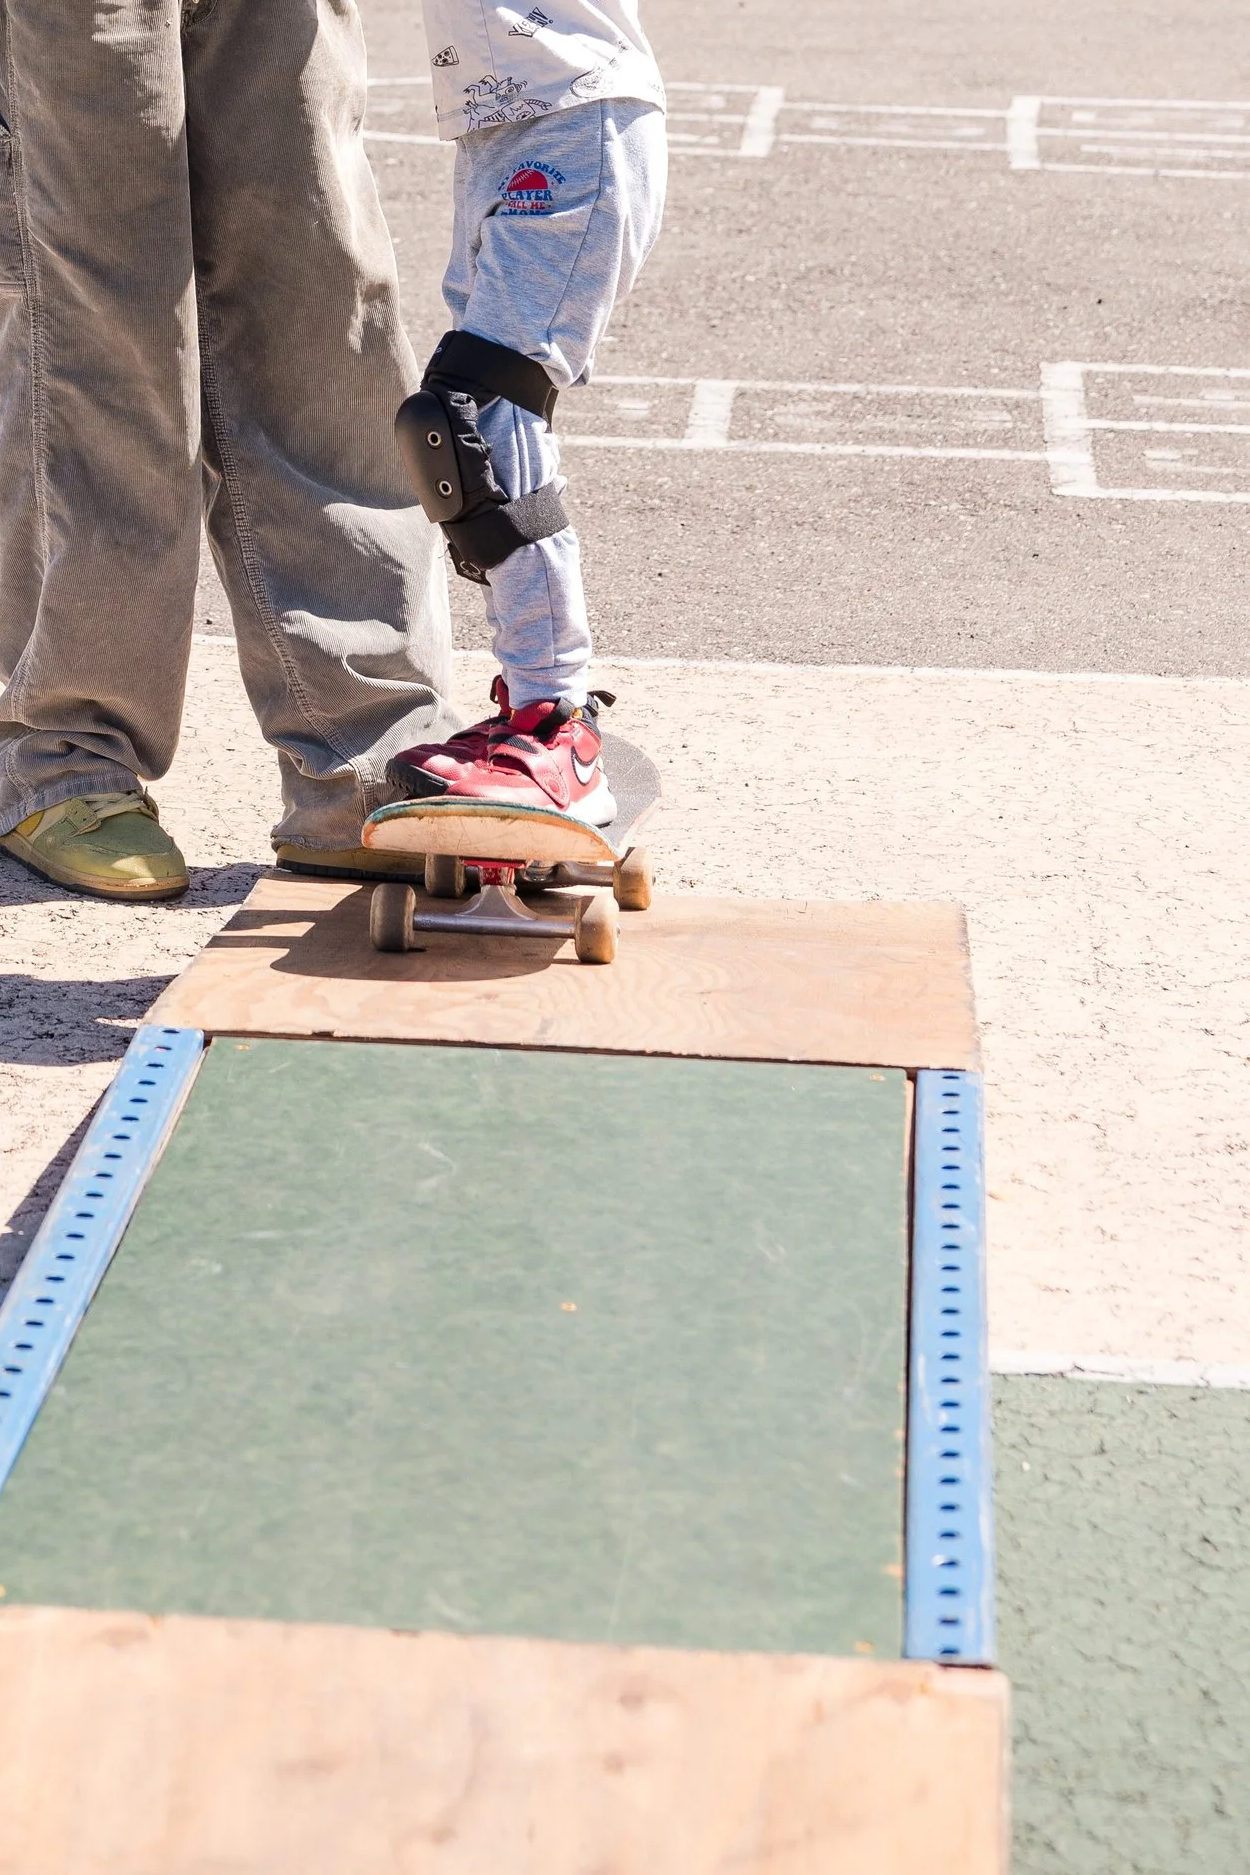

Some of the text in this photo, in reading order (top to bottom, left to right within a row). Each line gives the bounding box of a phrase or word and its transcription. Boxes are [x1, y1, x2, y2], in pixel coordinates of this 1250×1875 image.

[512, 160, 567, 185] AVORITE
[501, 189, 554, 202] PLAYER
[530, 201, 547, 210] ME
